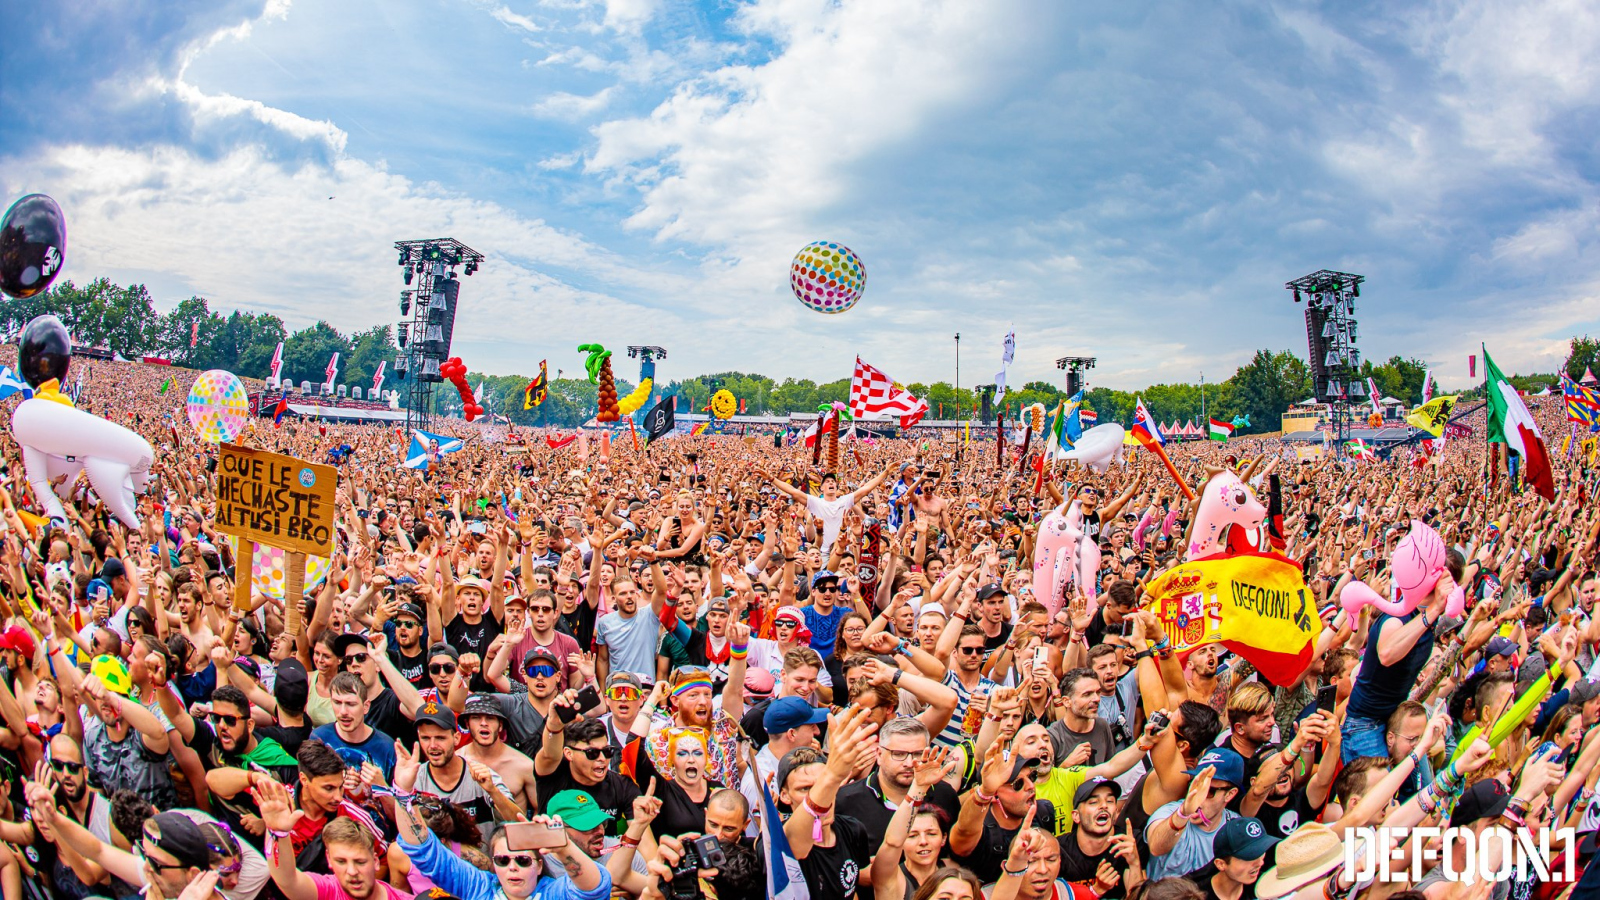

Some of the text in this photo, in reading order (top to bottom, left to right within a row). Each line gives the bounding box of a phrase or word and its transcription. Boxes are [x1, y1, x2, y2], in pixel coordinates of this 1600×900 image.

[223, 454, 263, 481] QUE
[270, 462, 291, 489] LE
[219, 475, 321, 519] HECHASTE
[288, 516, 329, 546] BRO
[1231, 580, 1290, 620] DEFQON.1
